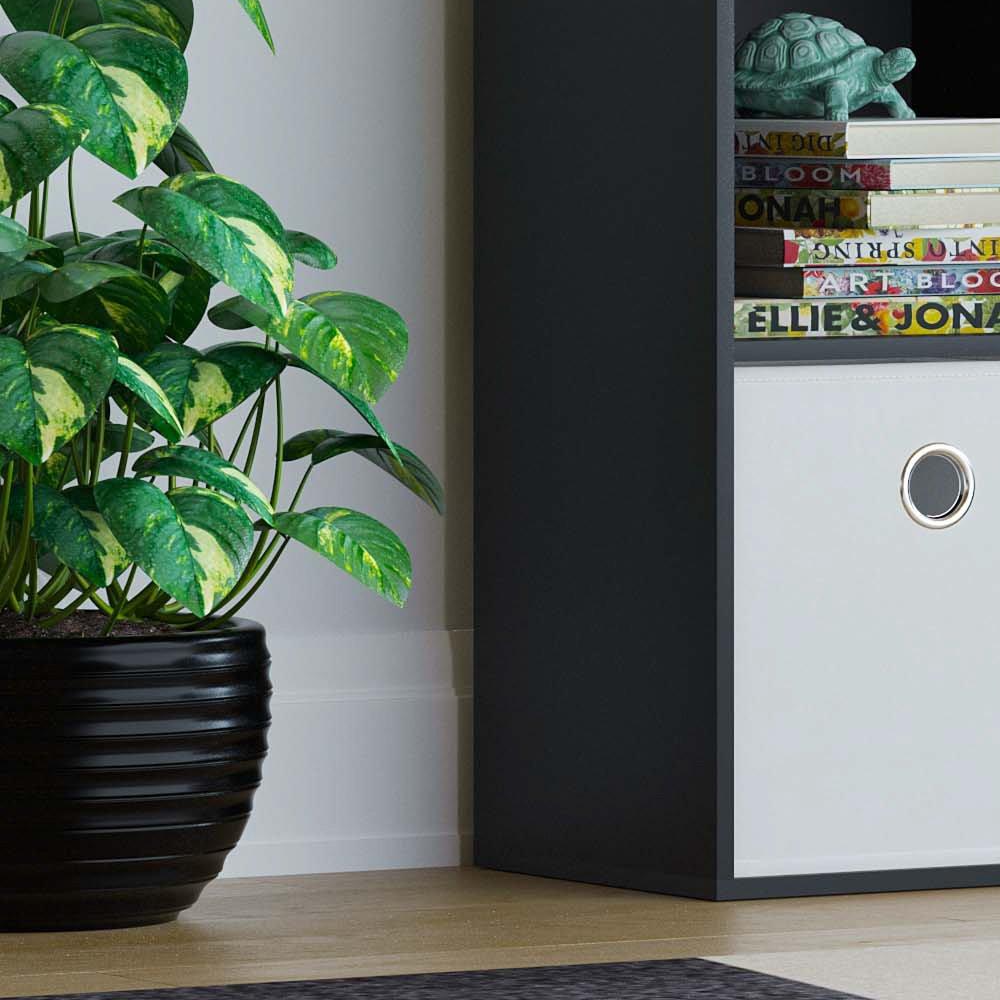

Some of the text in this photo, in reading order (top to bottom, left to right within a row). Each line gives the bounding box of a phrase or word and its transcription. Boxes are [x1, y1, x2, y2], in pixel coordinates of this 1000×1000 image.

[742, 165, 862, 183] BLOOM
[813, 241, 915, 260] SPRING
[819, 272, 897, 292] ART
[747, 305, 842, 333] ELLIE
[850, 304, 882, 331] &
